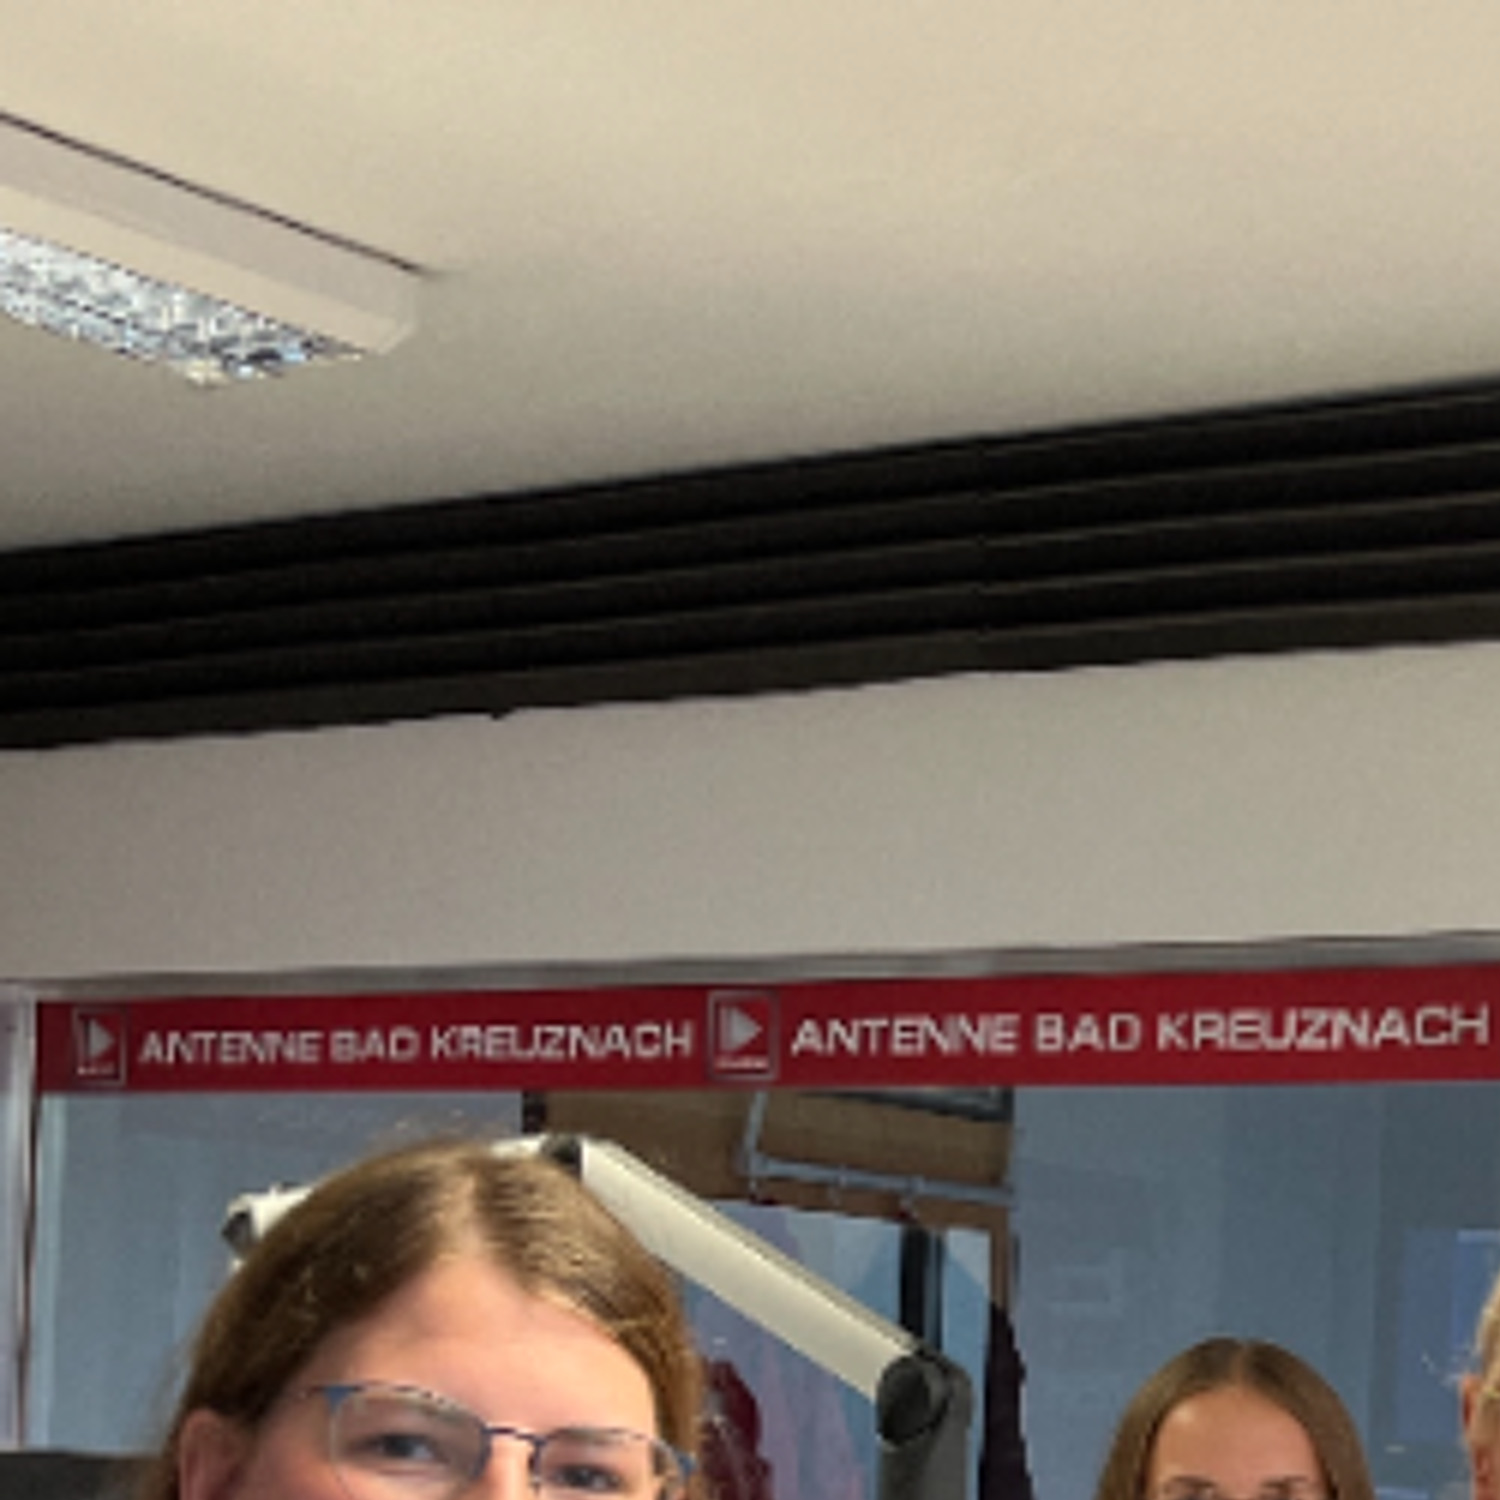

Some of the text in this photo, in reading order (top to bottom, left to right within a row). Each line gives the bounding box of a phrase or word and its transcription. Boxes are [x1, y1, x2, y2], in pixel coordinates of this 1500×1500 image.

[138, 1019, 696, 1064] ANTENNE BAD KREUZNACH
[790, 1000, 1491, 1056] ANTENNE BAD KREUZNACH
